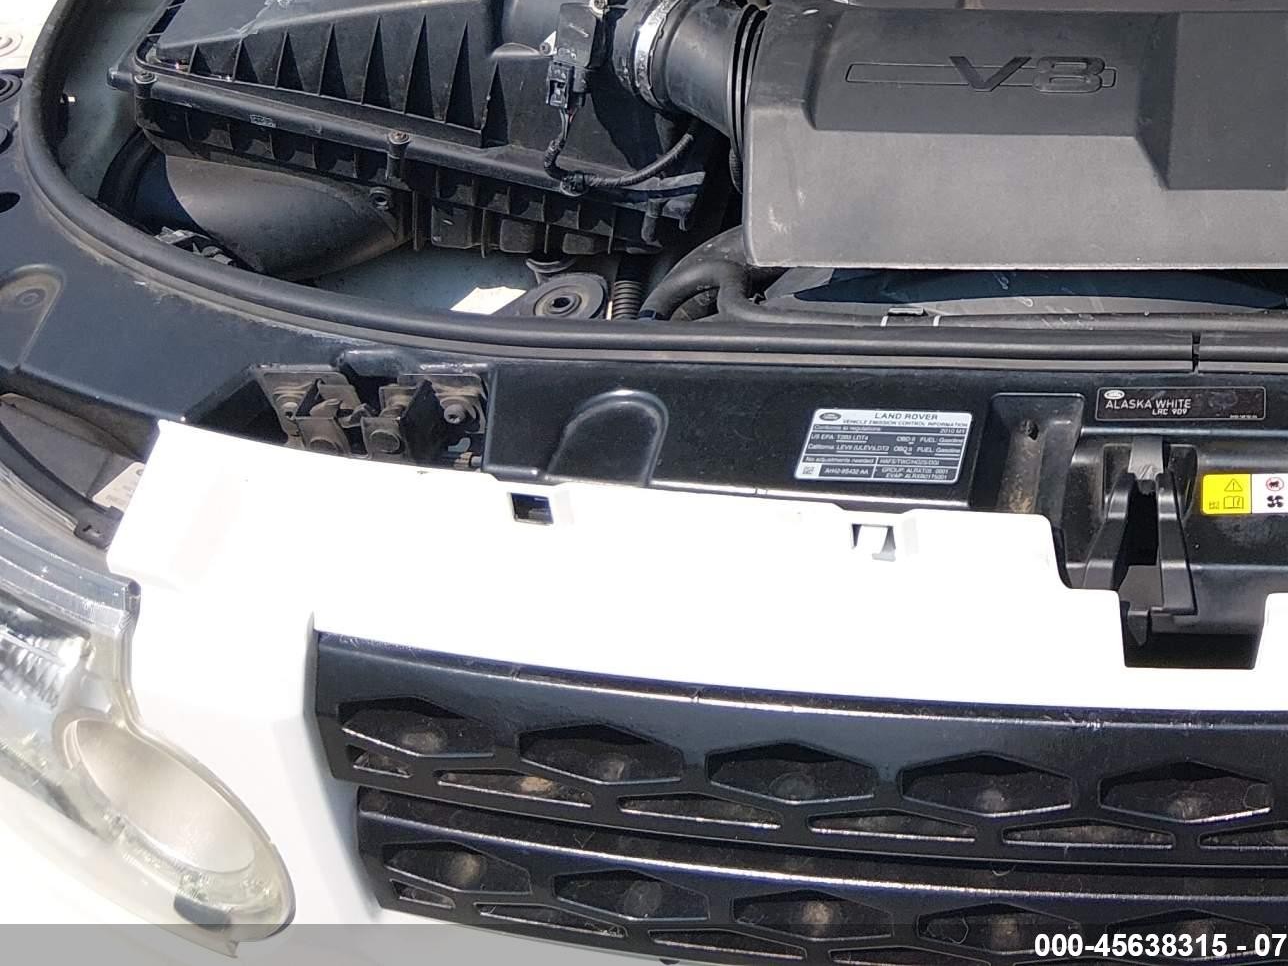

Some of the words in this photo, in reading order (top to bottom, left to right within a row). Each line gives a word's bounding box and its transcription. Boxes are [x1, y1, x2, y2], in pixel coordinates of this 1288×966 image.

[950, 56, 1105, 94] V8
[1105, 399, 1152, 410] ALASKA
[1155, 398, 1192, 409] WHITE
